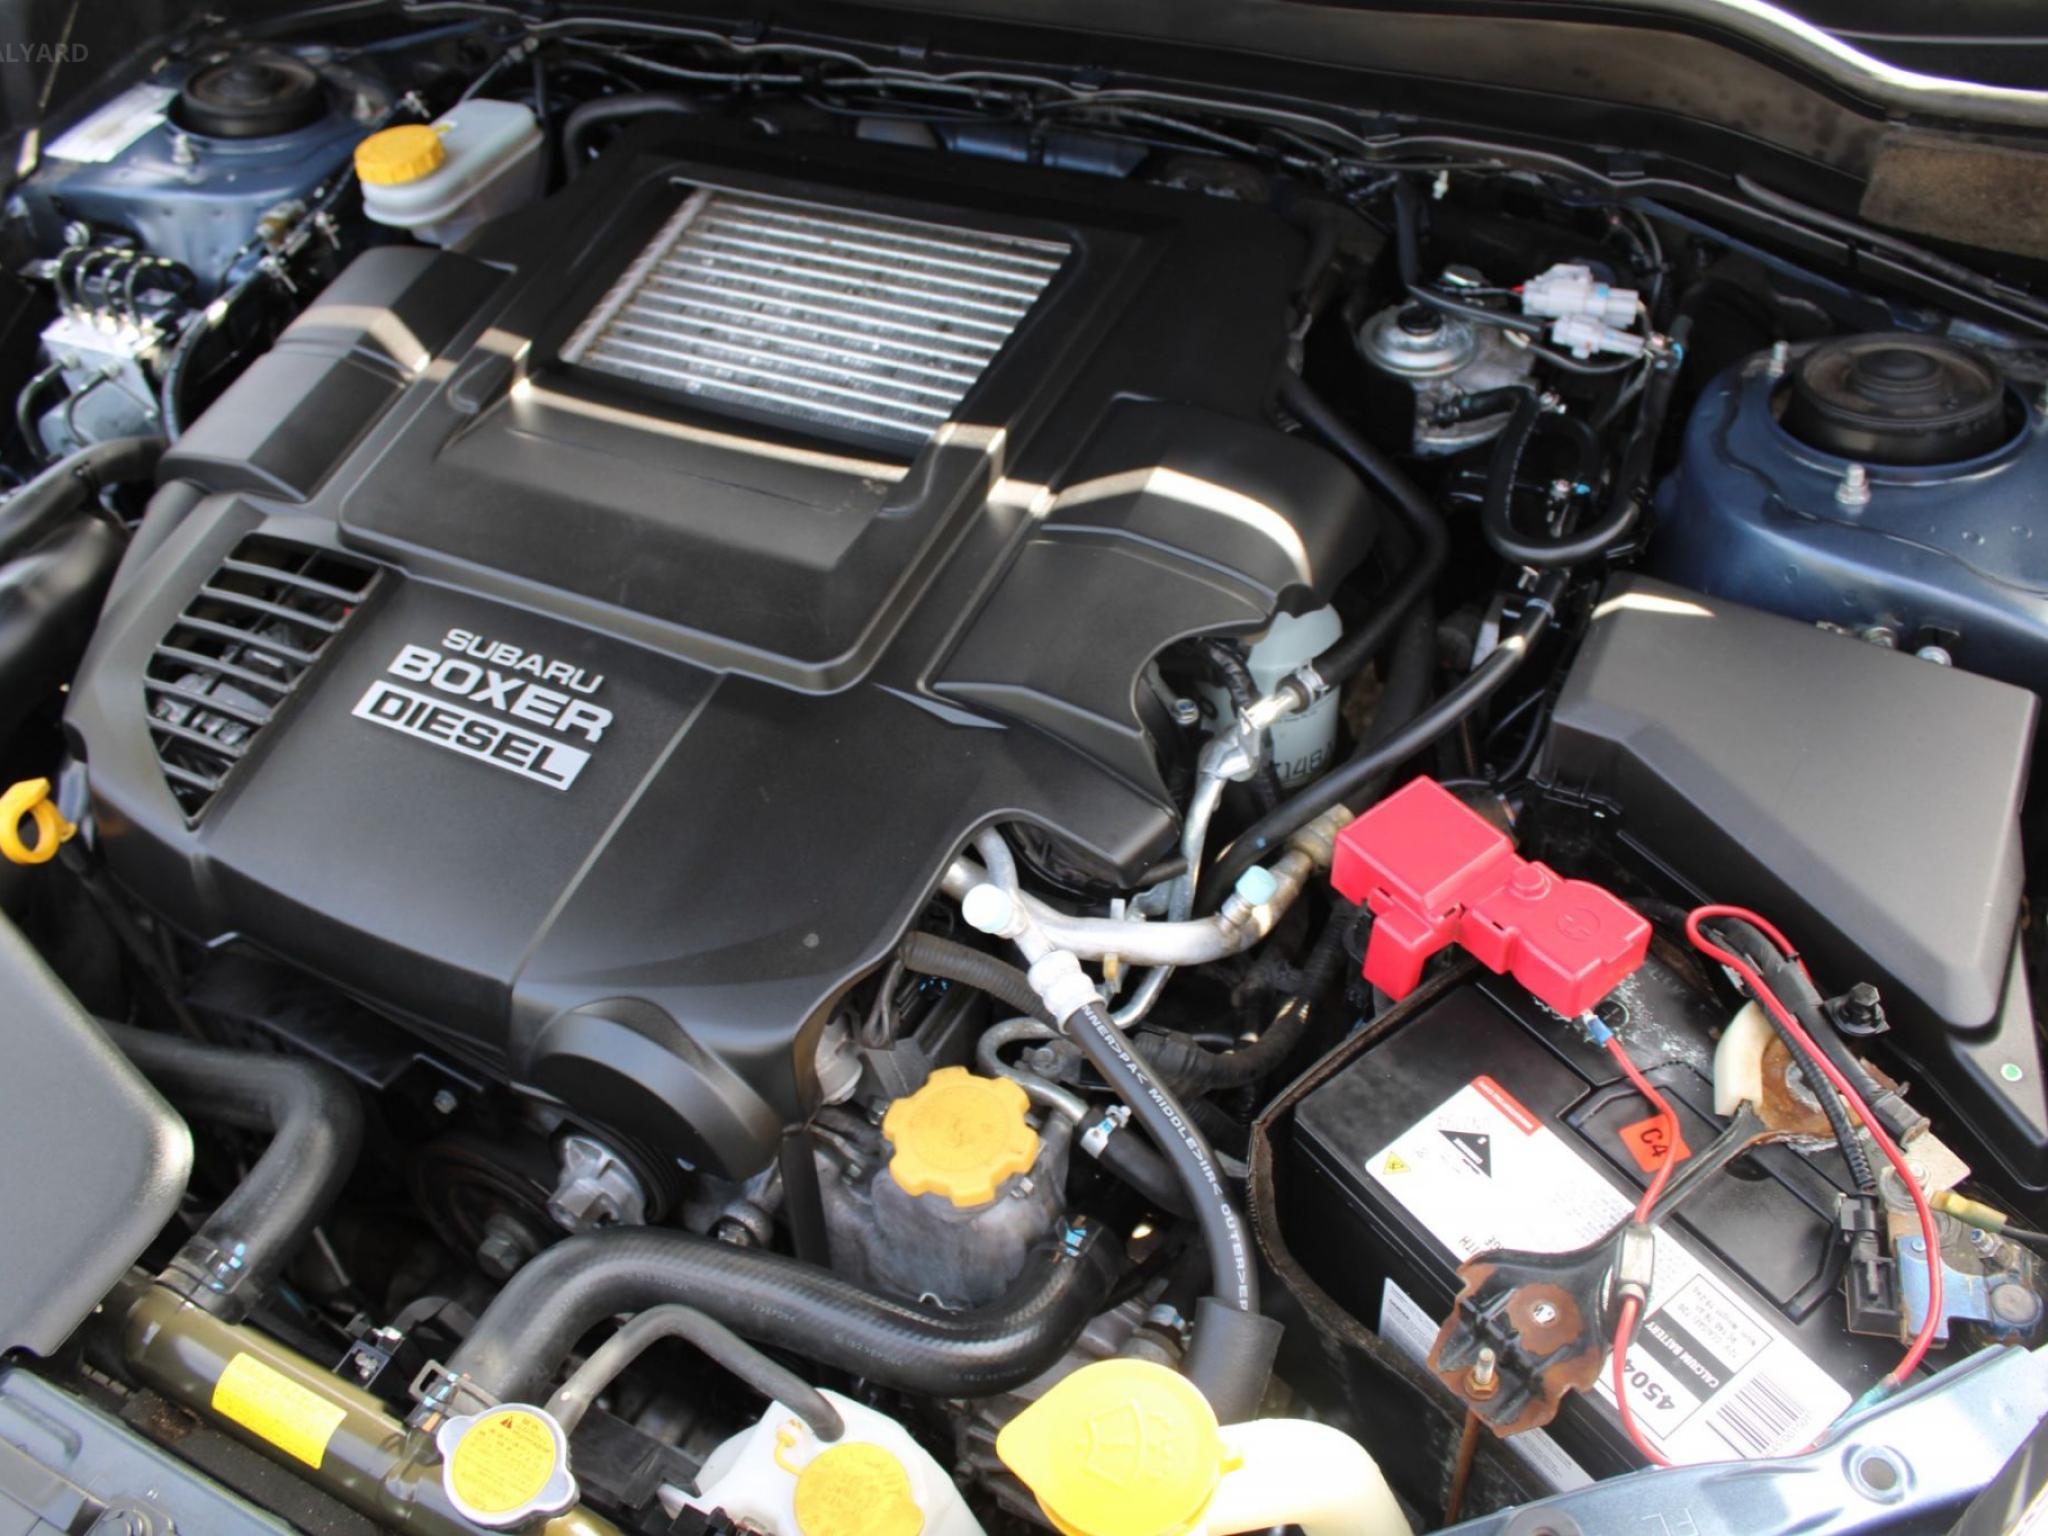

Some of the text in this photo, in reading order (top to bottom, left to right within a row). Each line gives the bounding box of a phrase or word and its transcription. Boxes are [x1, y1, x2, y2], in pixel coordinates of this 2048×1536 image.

[387, 644, 614, 743] BOXER
[442, 628, 605, 694] SUBARU
[368, 690, 566, 783] DIESEL
[1081, 1003, 1149, 1085] NNER>PA<
[1220, 1203, 1249, 1311] OUTER>EP
[1640, 1127, 1669, 1158] C4
[1644, 1319, 1720, 1389] CALCIUM BATTERY
